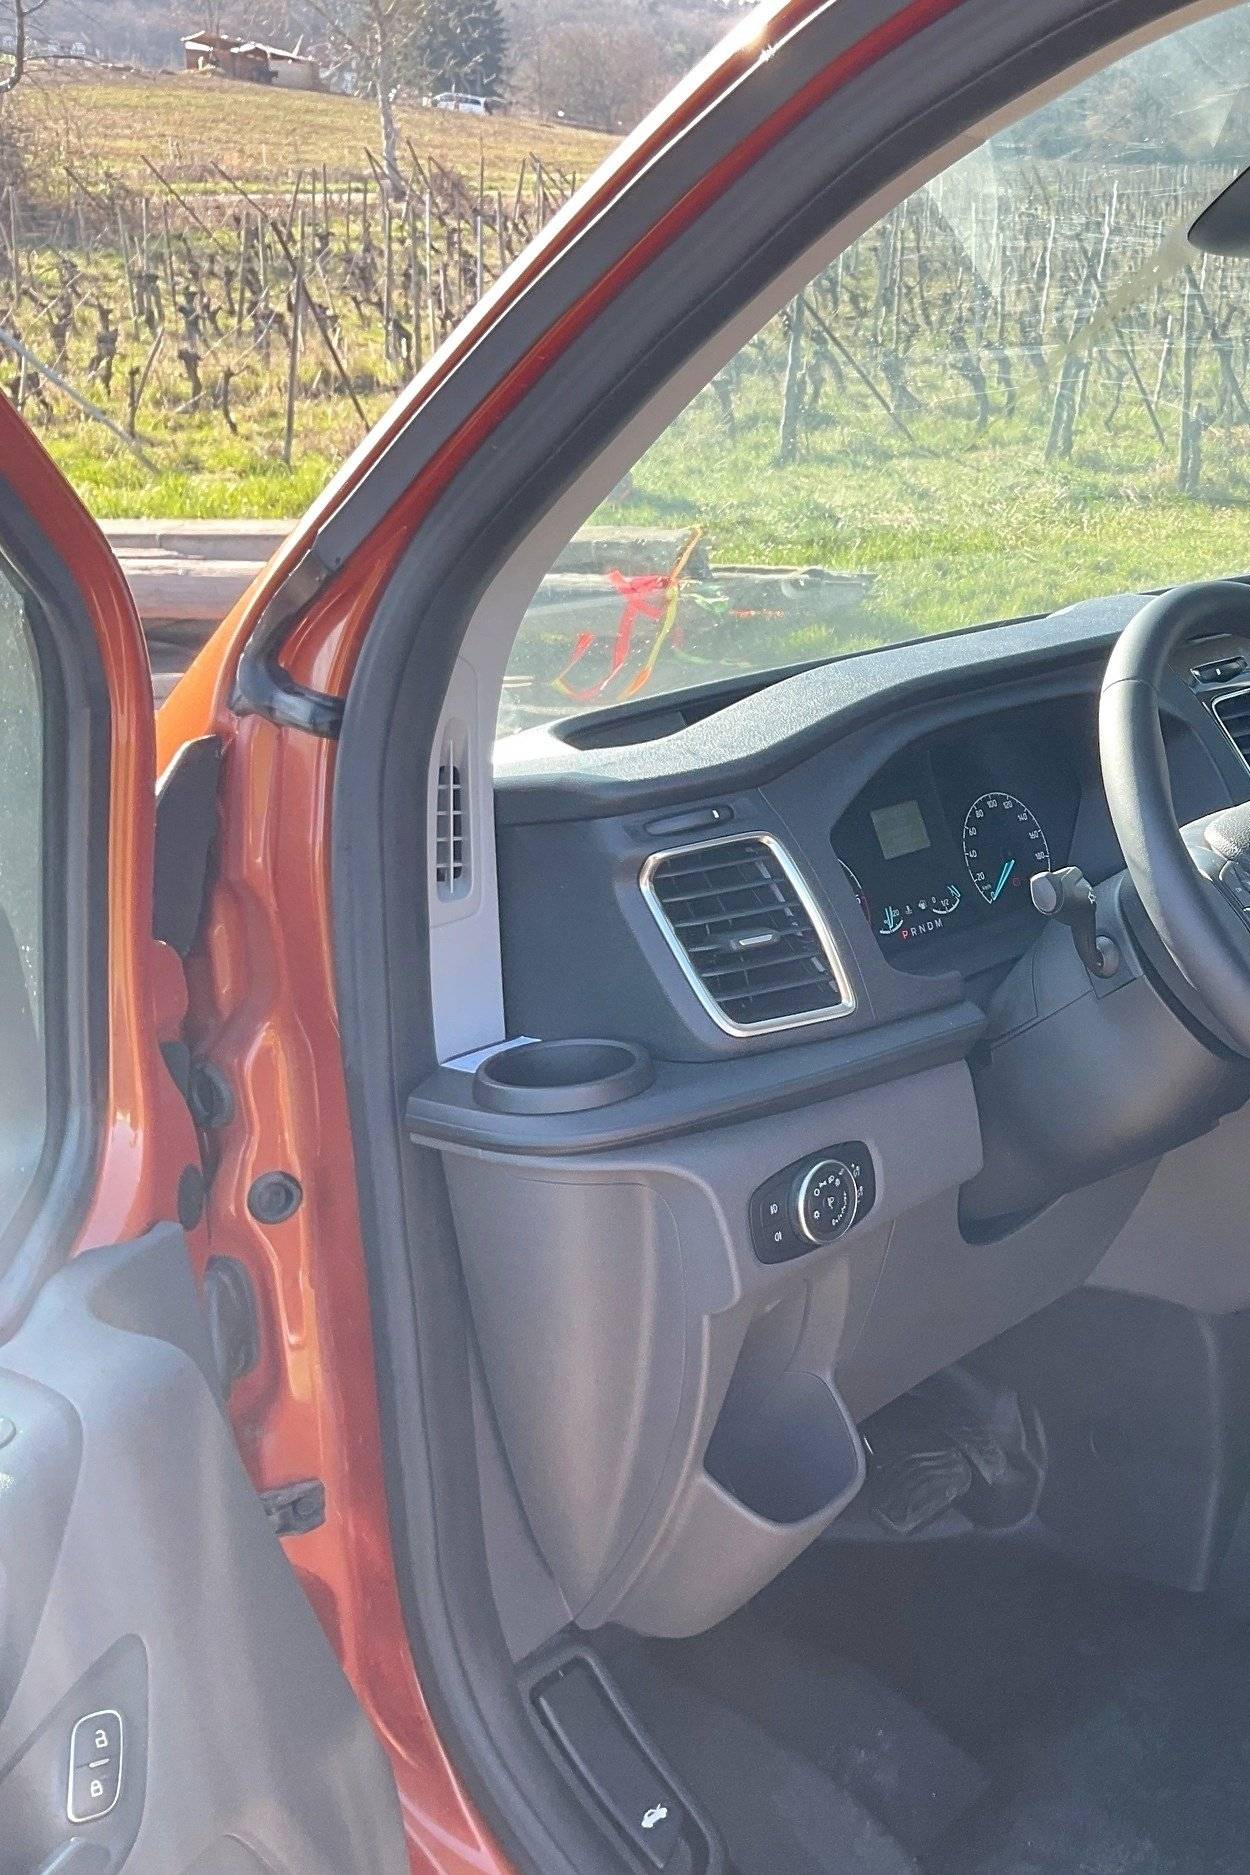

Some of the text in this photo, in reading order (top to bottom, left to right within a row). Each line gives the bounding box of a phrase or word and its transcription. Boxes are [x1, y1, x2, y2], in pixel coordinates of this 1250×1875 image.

[986, 799, 998, 808] 100
[1003, 800, 1013, 809] 120
[975, 809, 984, 818] 80
[968, 826, 977, 836] 60
[976, 871, 985, 881] 20
